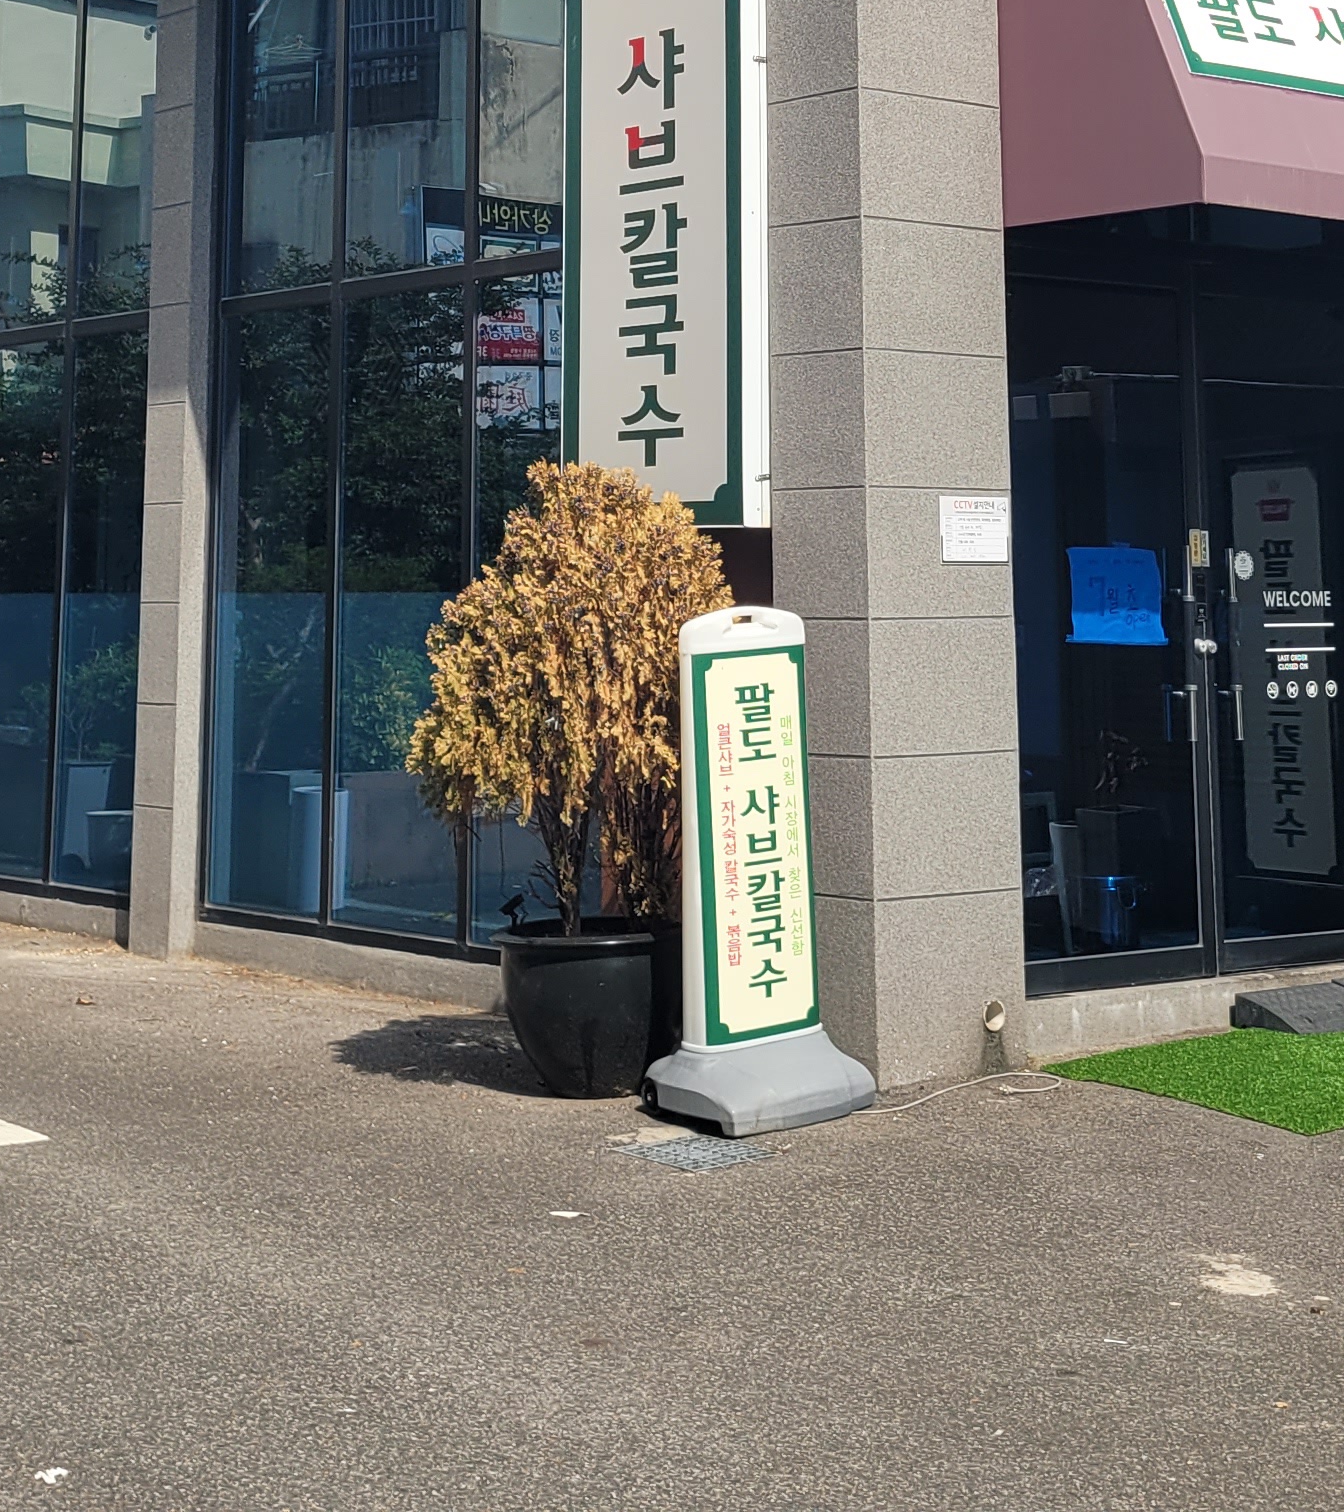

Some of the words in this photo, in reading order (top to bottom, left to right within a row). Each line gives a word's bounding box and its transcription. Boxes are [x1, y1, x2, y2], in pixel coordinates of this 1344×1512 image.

[616, 27, 688, 468] 샤브칼국수
[953, 499, 973, 510] CCTV
[1262, 590, 1332, 608] WELCOME
[733, 682, 778, 764] 팔도
[779, 715, 794, 747] 매일
[716, 722, 735, 777] 얼큰샤브
[782, 756, 796, 787] 아침
[720, 800, 738, 855] 자가숙성
[783, 798, 801, 858] 시장에서
[723, 859, 741, 901] 칼국수
[739, 784, 788, 999] 샤브칼국수
[787, 866, 803, 900] 찾은
[725, 924, 742, 967] 볶음밥
[789, 907, 805, 957] 신선함
